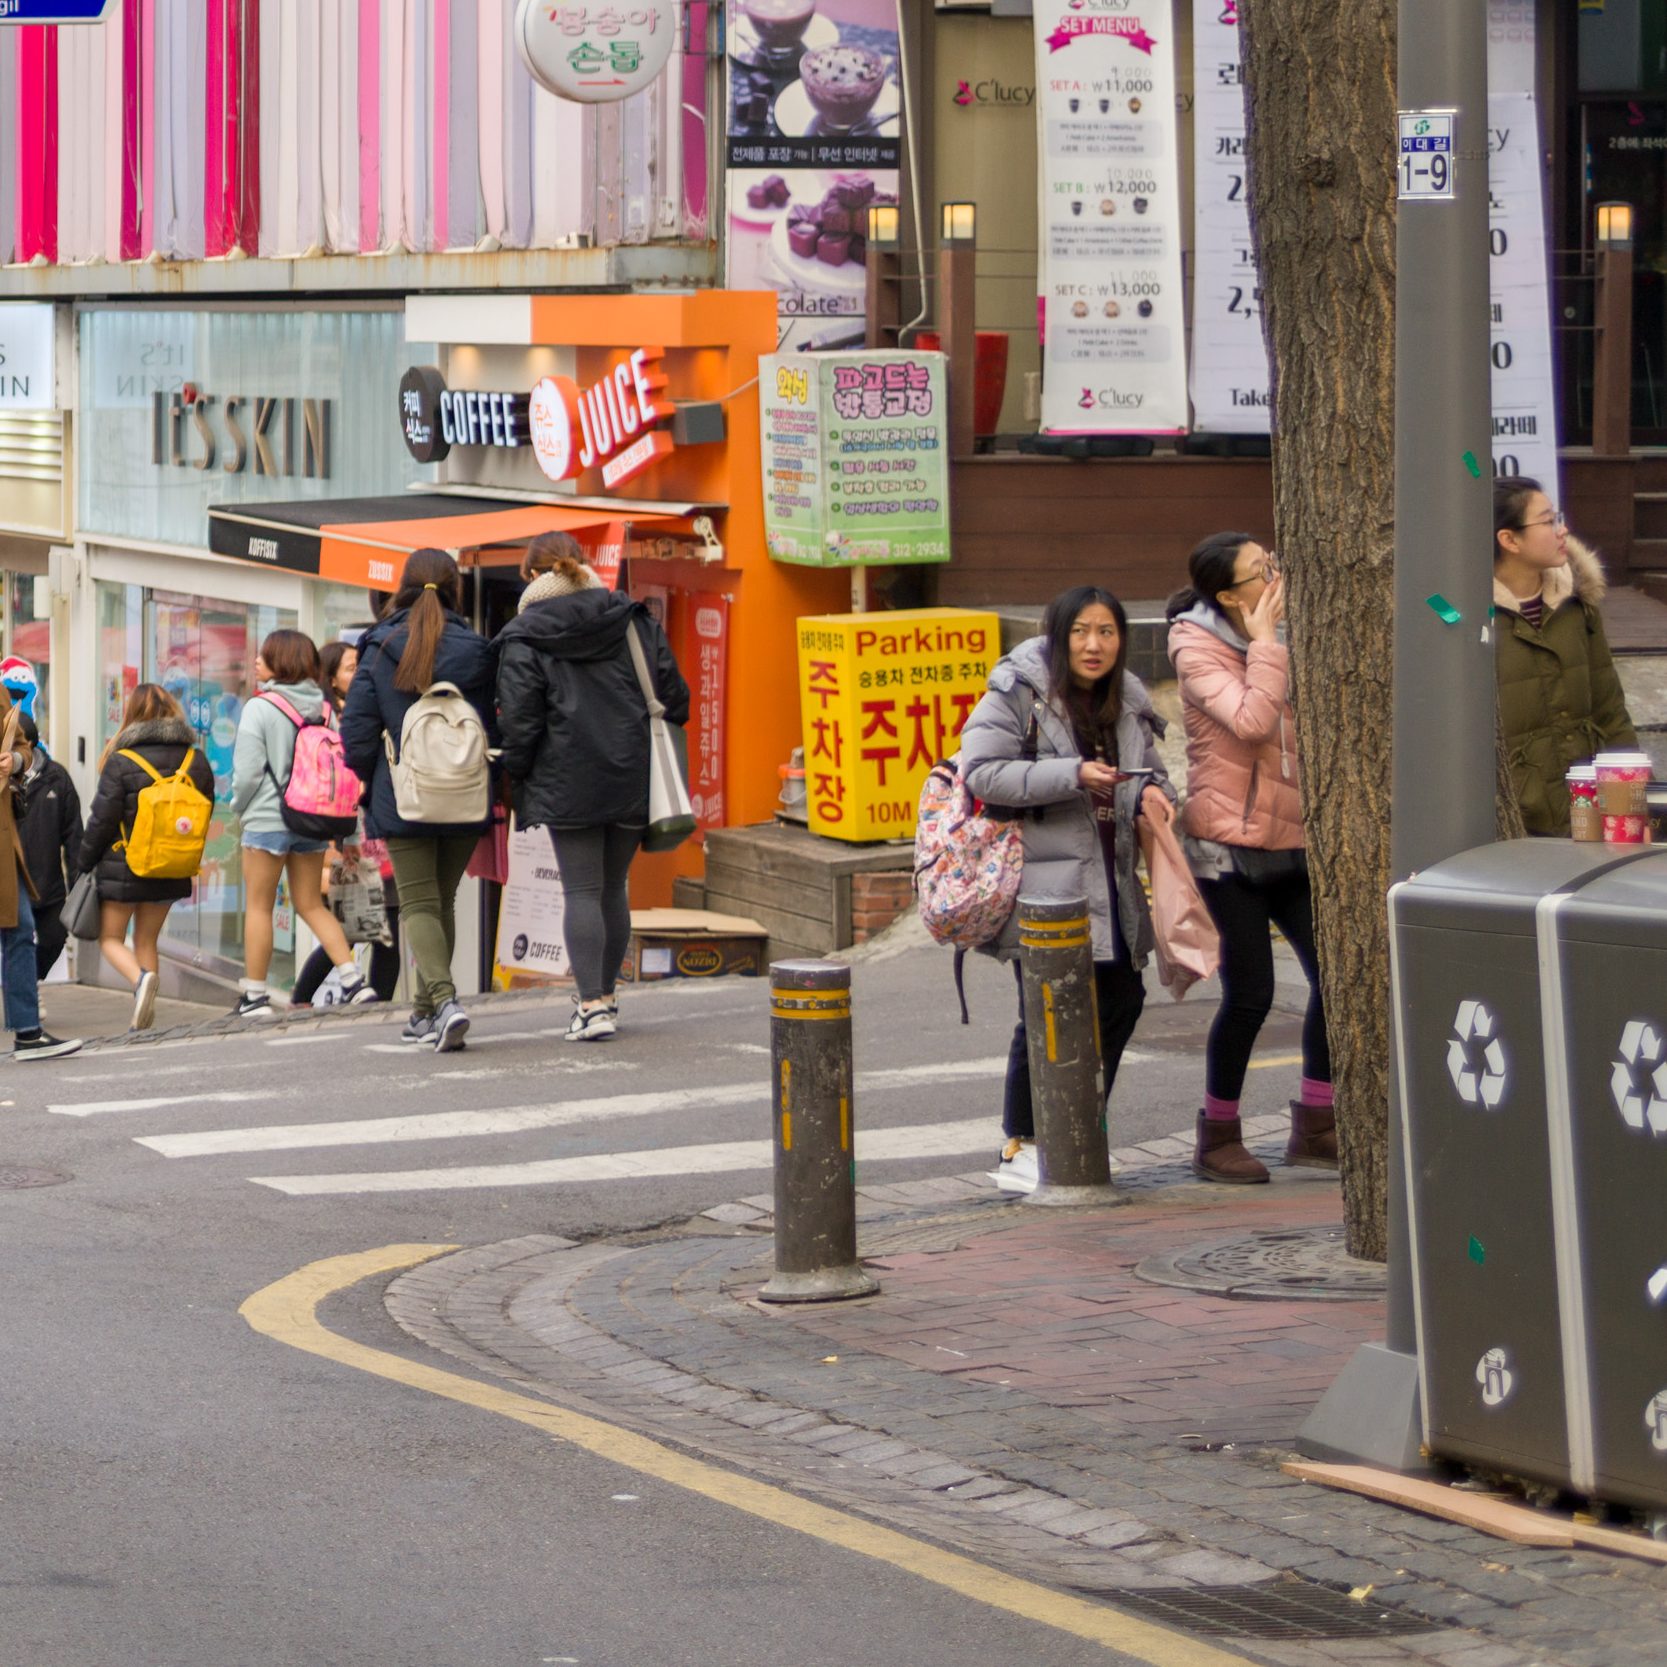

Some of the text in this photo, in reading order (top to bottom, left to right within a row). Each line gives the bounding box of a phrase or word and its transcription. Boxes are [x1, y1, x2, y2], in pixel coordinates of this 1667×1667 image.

[1059, 15, 1141, 34] SET MENU
[1050, 79, 1069, 92] SET
[1403, 153, 1448, 193] 1-9
[1052, 182, 1072, 194] SET
[1055, 284, 1075, 296] SET
[439, 389, 517, 447] COFFEE
[577, 347, 655, 468] JUICE
[223, 395, 331, 480] SKIN
[593, 543, 620, 567] JUICE
[367, 559, 394, 583] ZUSSIX
[854, 625, 987, 658] Parking
[858, 667, 905, 689] 승용차
[958, 661, 988, 681] 주차
[808, 659, 846, 824] 주차장
[866, 801, 912, 824] 10M
[275, 913, 290, 931] SALE
[529, 941, 563, 962] COFFEE
